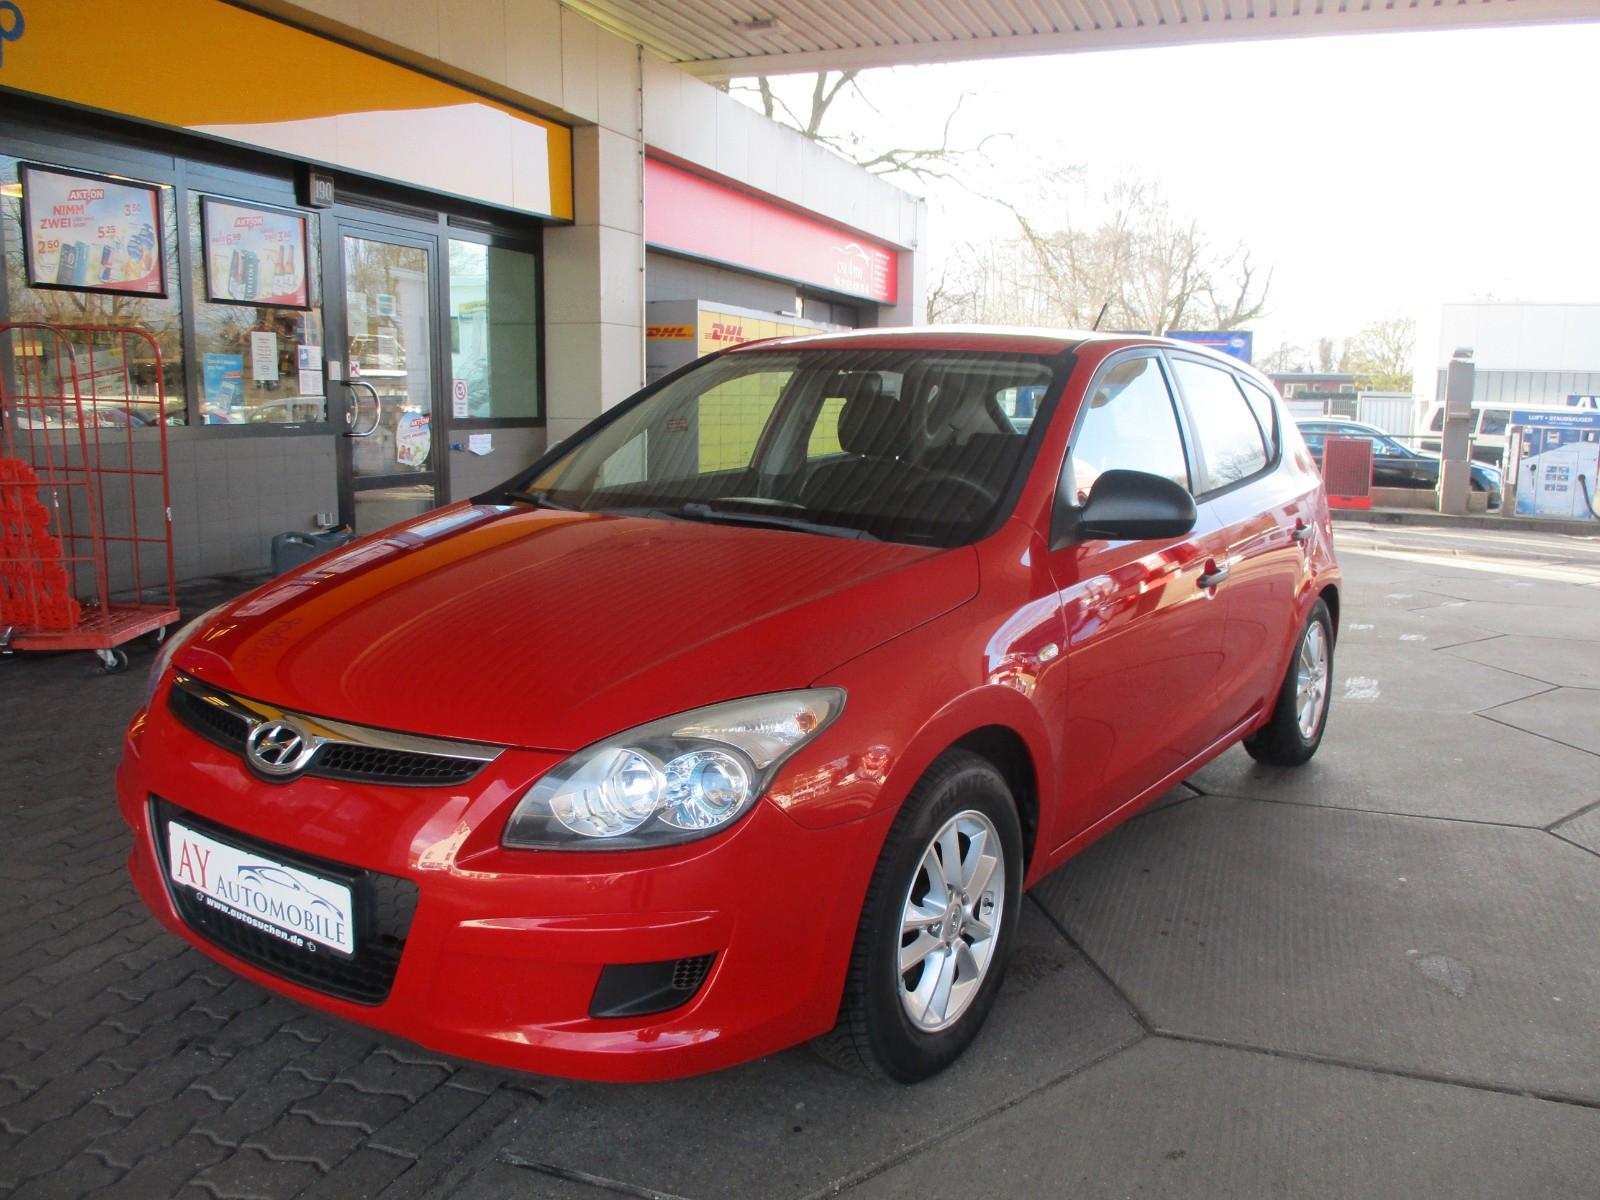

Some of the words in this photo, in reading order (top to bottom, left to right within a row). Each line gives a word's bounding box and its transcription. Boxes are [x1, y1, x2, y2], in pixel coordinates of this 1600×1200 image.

[315, 180, 332, 201] 190
[52, 204, 84, 216] NIMM
[40, 217, 72, 230] ZWEI
[646, 326, 688, 337] DHL
[711, 323, 745, 343] DHL
[178, 838, 211, 889] AY
[215, 873, 346, 945] AUTOMOBILE
[205, 896, 304, 948] www.autosuchen.de
